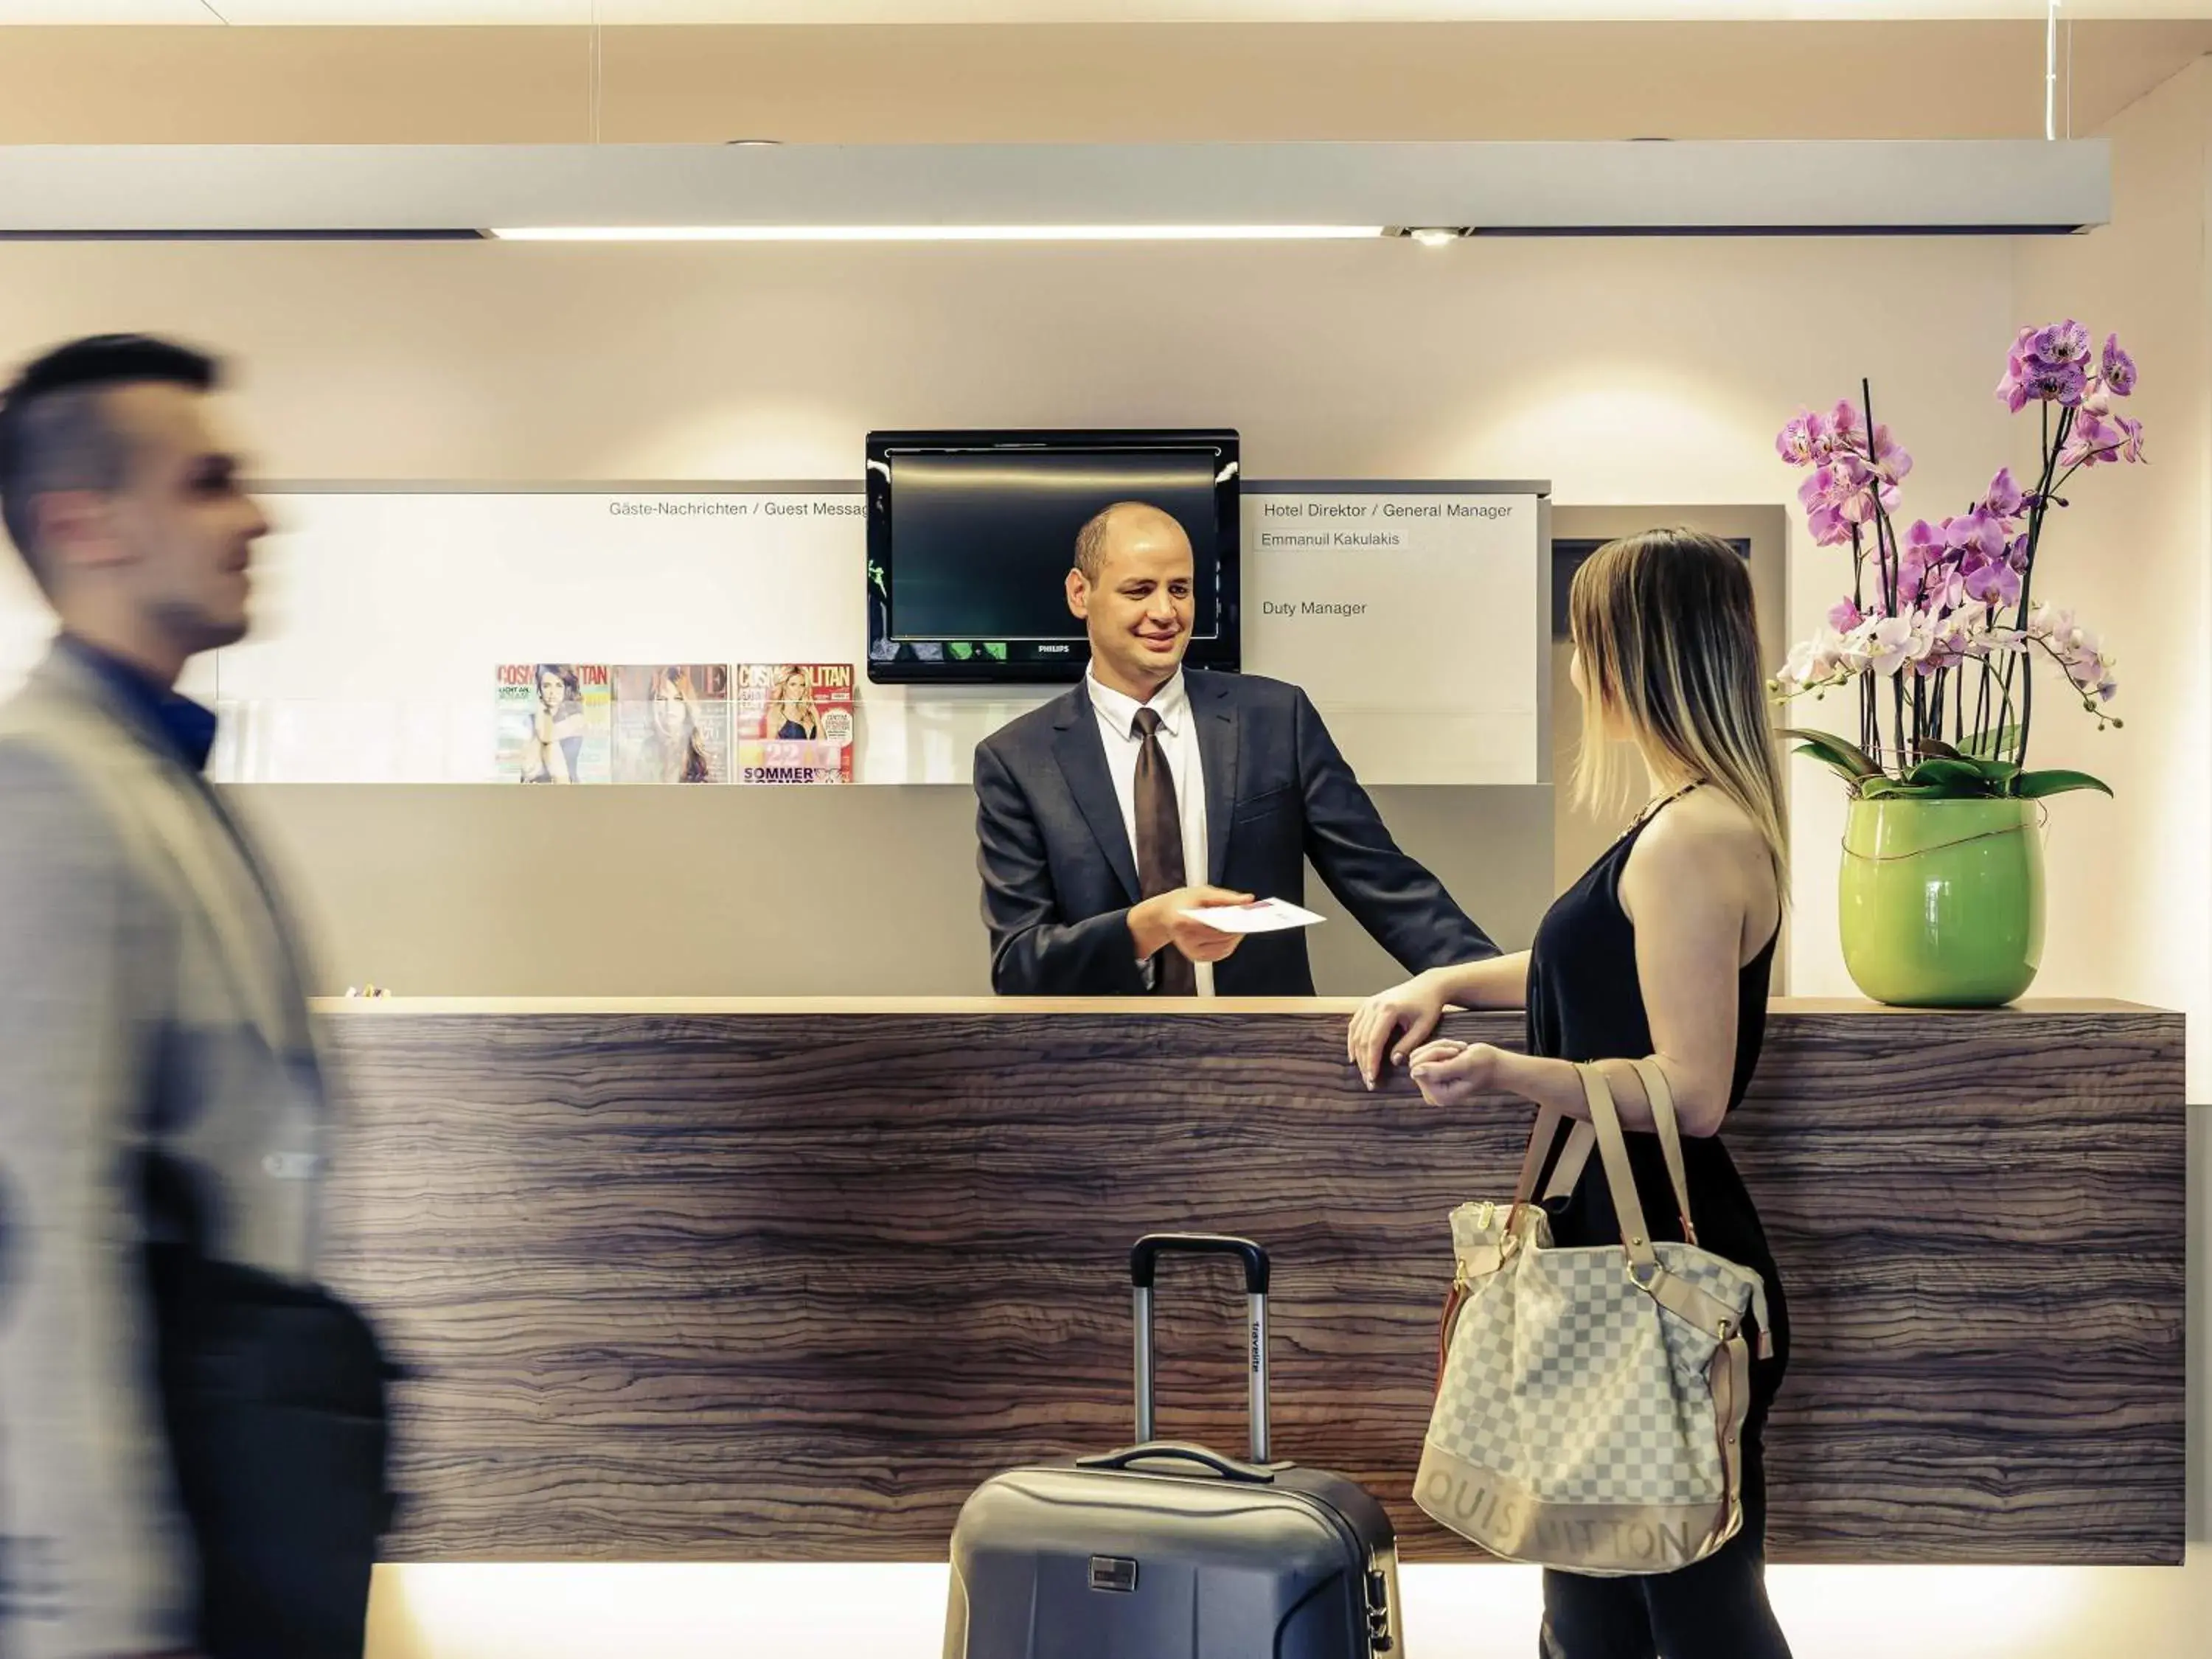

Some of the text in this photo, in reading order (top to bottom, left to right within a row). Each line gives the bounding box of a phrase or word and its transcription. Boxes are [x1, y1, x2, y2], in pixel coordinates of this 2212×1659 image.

[609, 502, 867, 519] Gäste-Nachrichten / Guest Messag
[1265, 503, 1513, 520] Hotel Direktor / General Manager
[1262, 532, 1400, 546] Emmanuil Kakulakis
[1262, 601, 1368, 618] Duty Manager
[498, 664, 608, 684] COSMITAN
[738, 665, 850, 687] COSMOLITAN
[1427, 1470, 1690, 1564] OUIS UITTON
